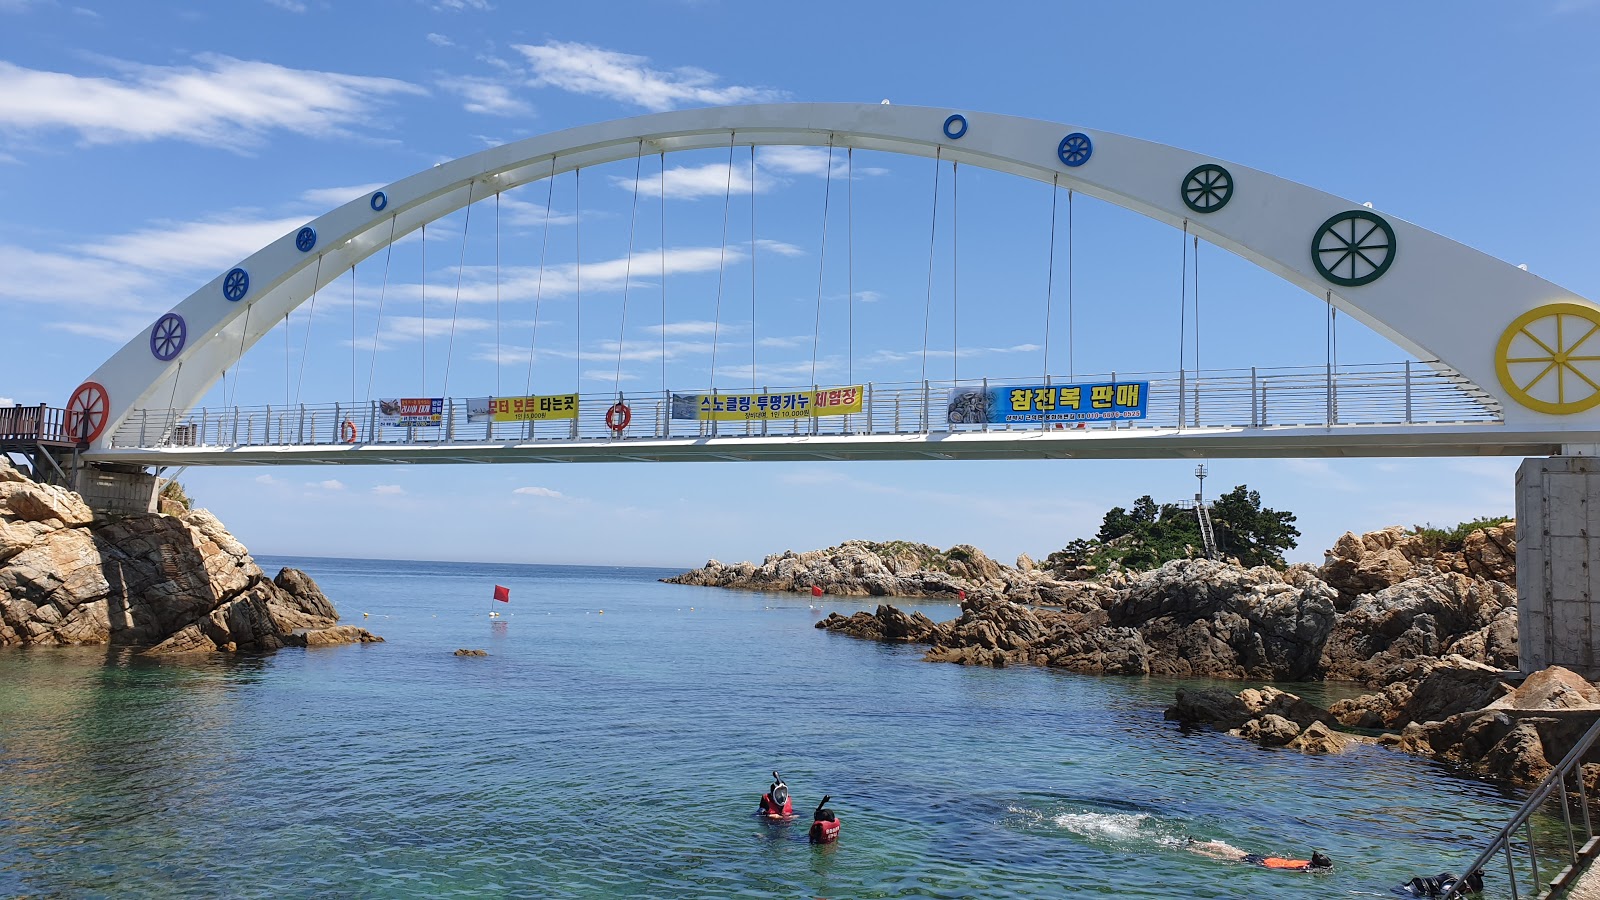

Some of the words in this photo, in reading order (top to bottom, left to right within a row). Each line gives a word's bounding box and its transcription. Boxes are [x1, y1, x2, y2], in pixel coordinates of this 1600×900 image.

[488, 400, 509, 414] 모터
[514, 398, 535, 413] 보트
[540, 396, 574, 412] 타는곳
[814, 388, 857, 407] 체험장
[1009, 386, 1082, 411] 참전복
[1090, 384, 1140, 409] 판매
[782, 409, 810, 418] 10,000원
